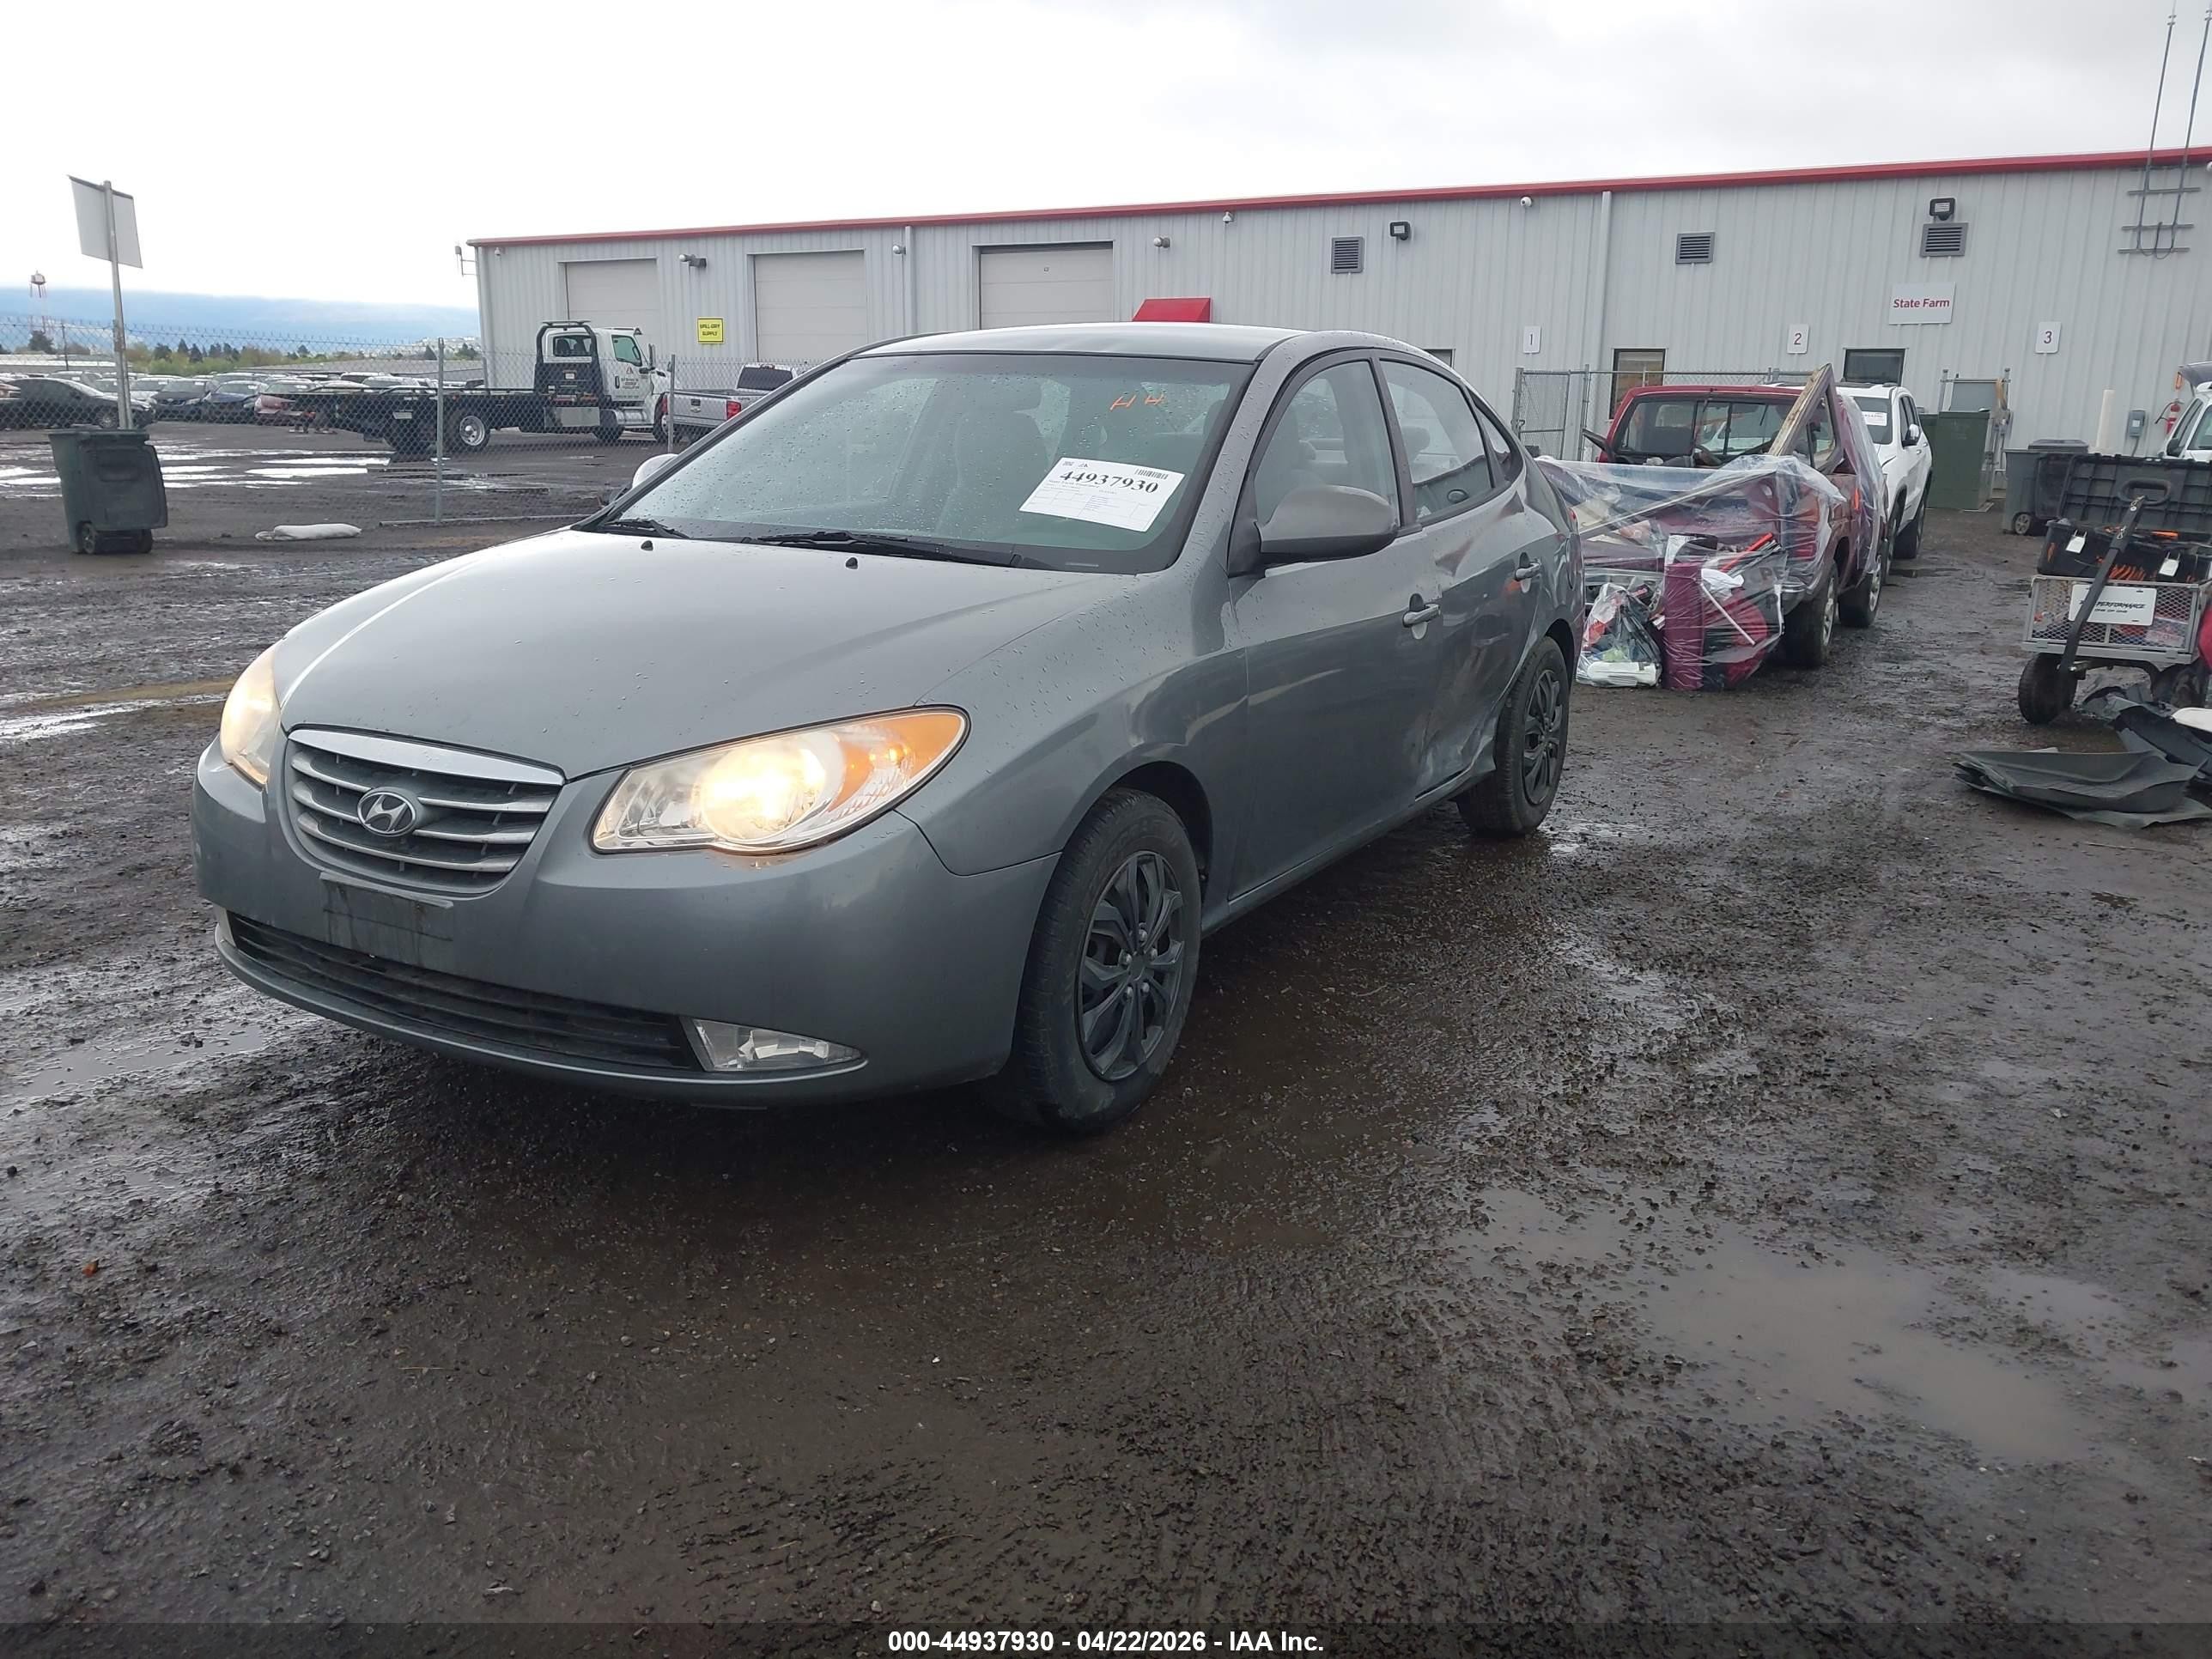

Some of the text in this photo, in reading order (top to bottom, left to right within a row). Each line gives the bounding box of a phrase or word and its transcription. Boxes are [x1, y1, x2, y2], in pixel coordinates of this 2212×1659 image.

[1893, 298, 1950, 308] State Farm
[1794, 332, 1802, 345] 2
[2044, 331, 2052, 344] 3
[1060, 471, 1159, 494] 44937930
